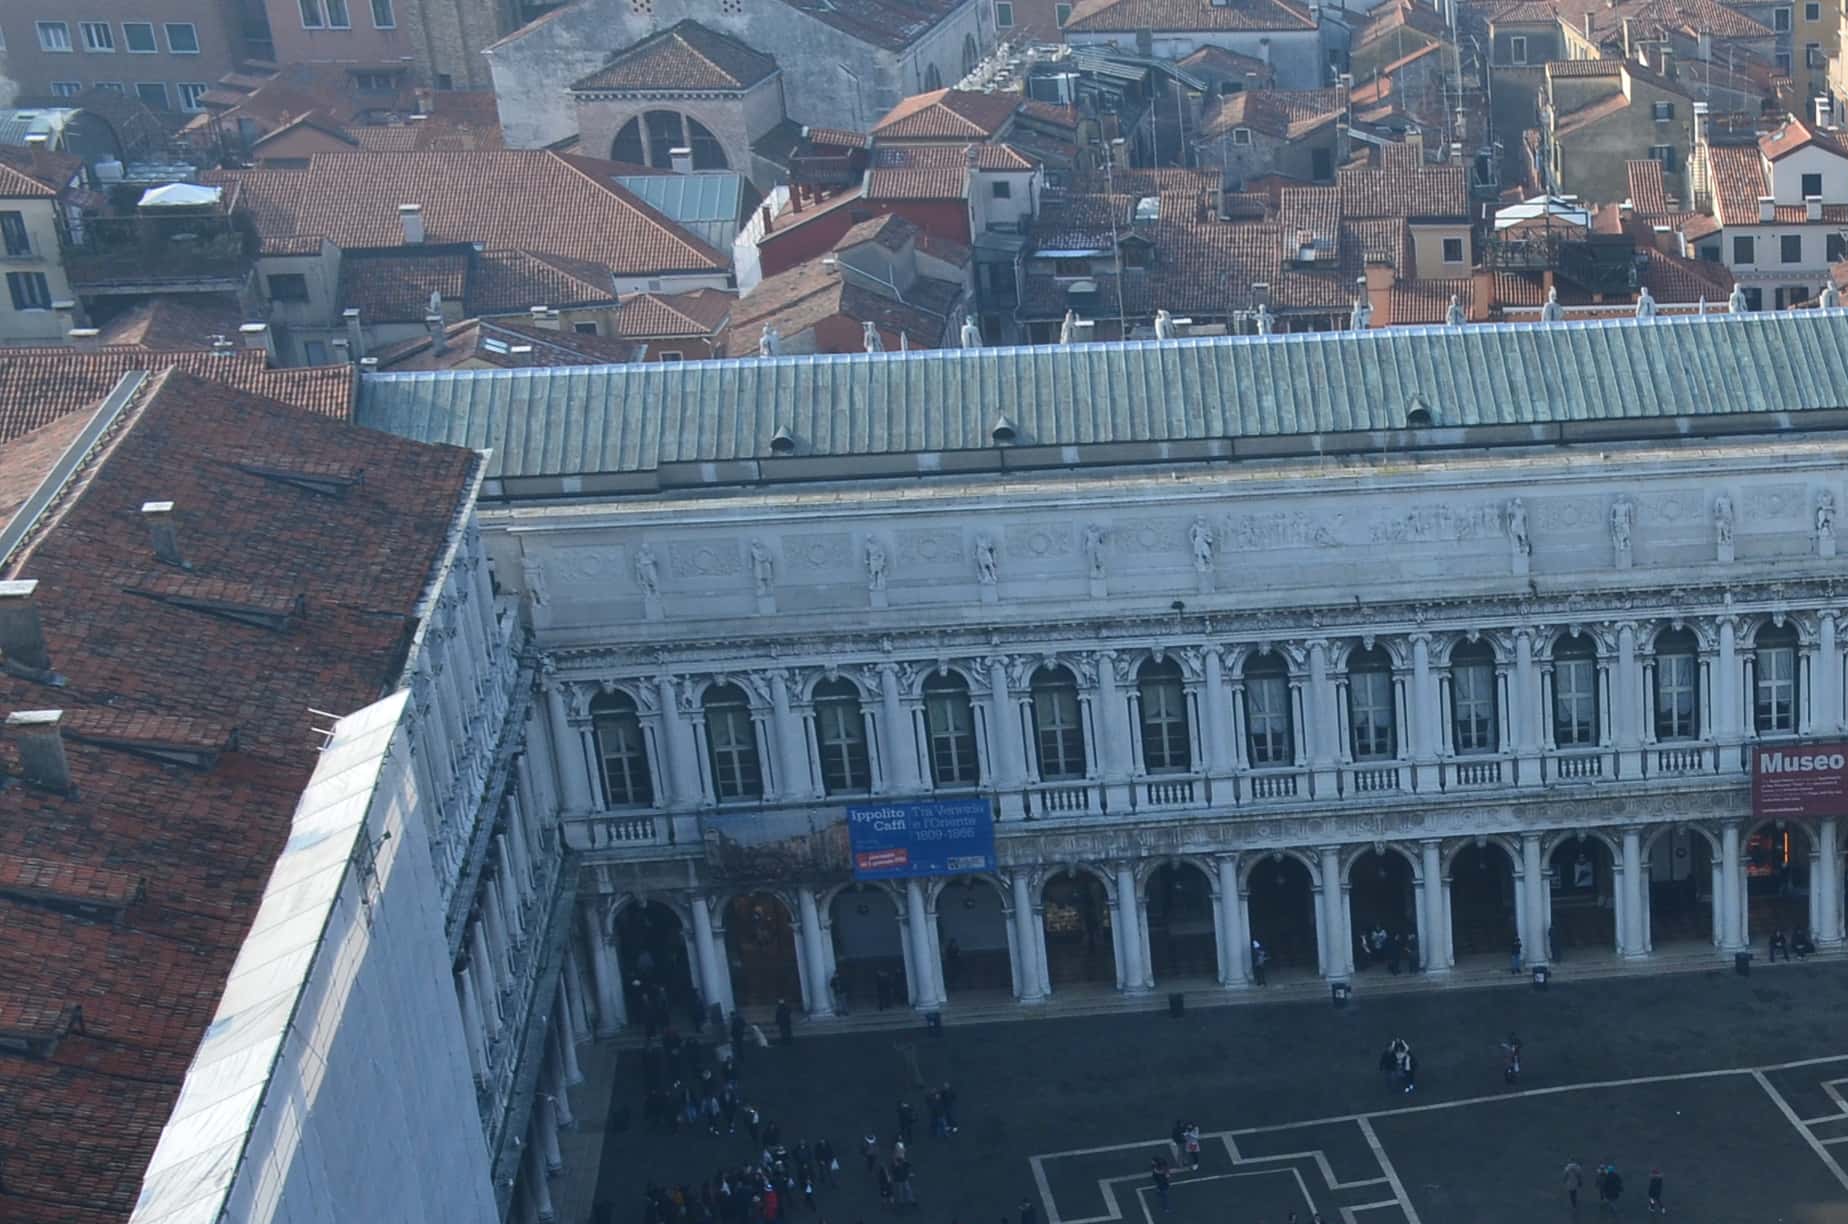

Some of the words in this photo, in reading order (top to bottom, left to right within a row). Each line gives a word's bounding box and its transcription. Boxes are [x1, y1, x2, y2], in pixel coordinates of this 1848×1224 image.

[1761, 752, 1844, 774] Museo
[851, 808, 905, 823] Ippolito
[911, 806, 934, 817] Tra
[874, 820, 906, 832] Caffi
